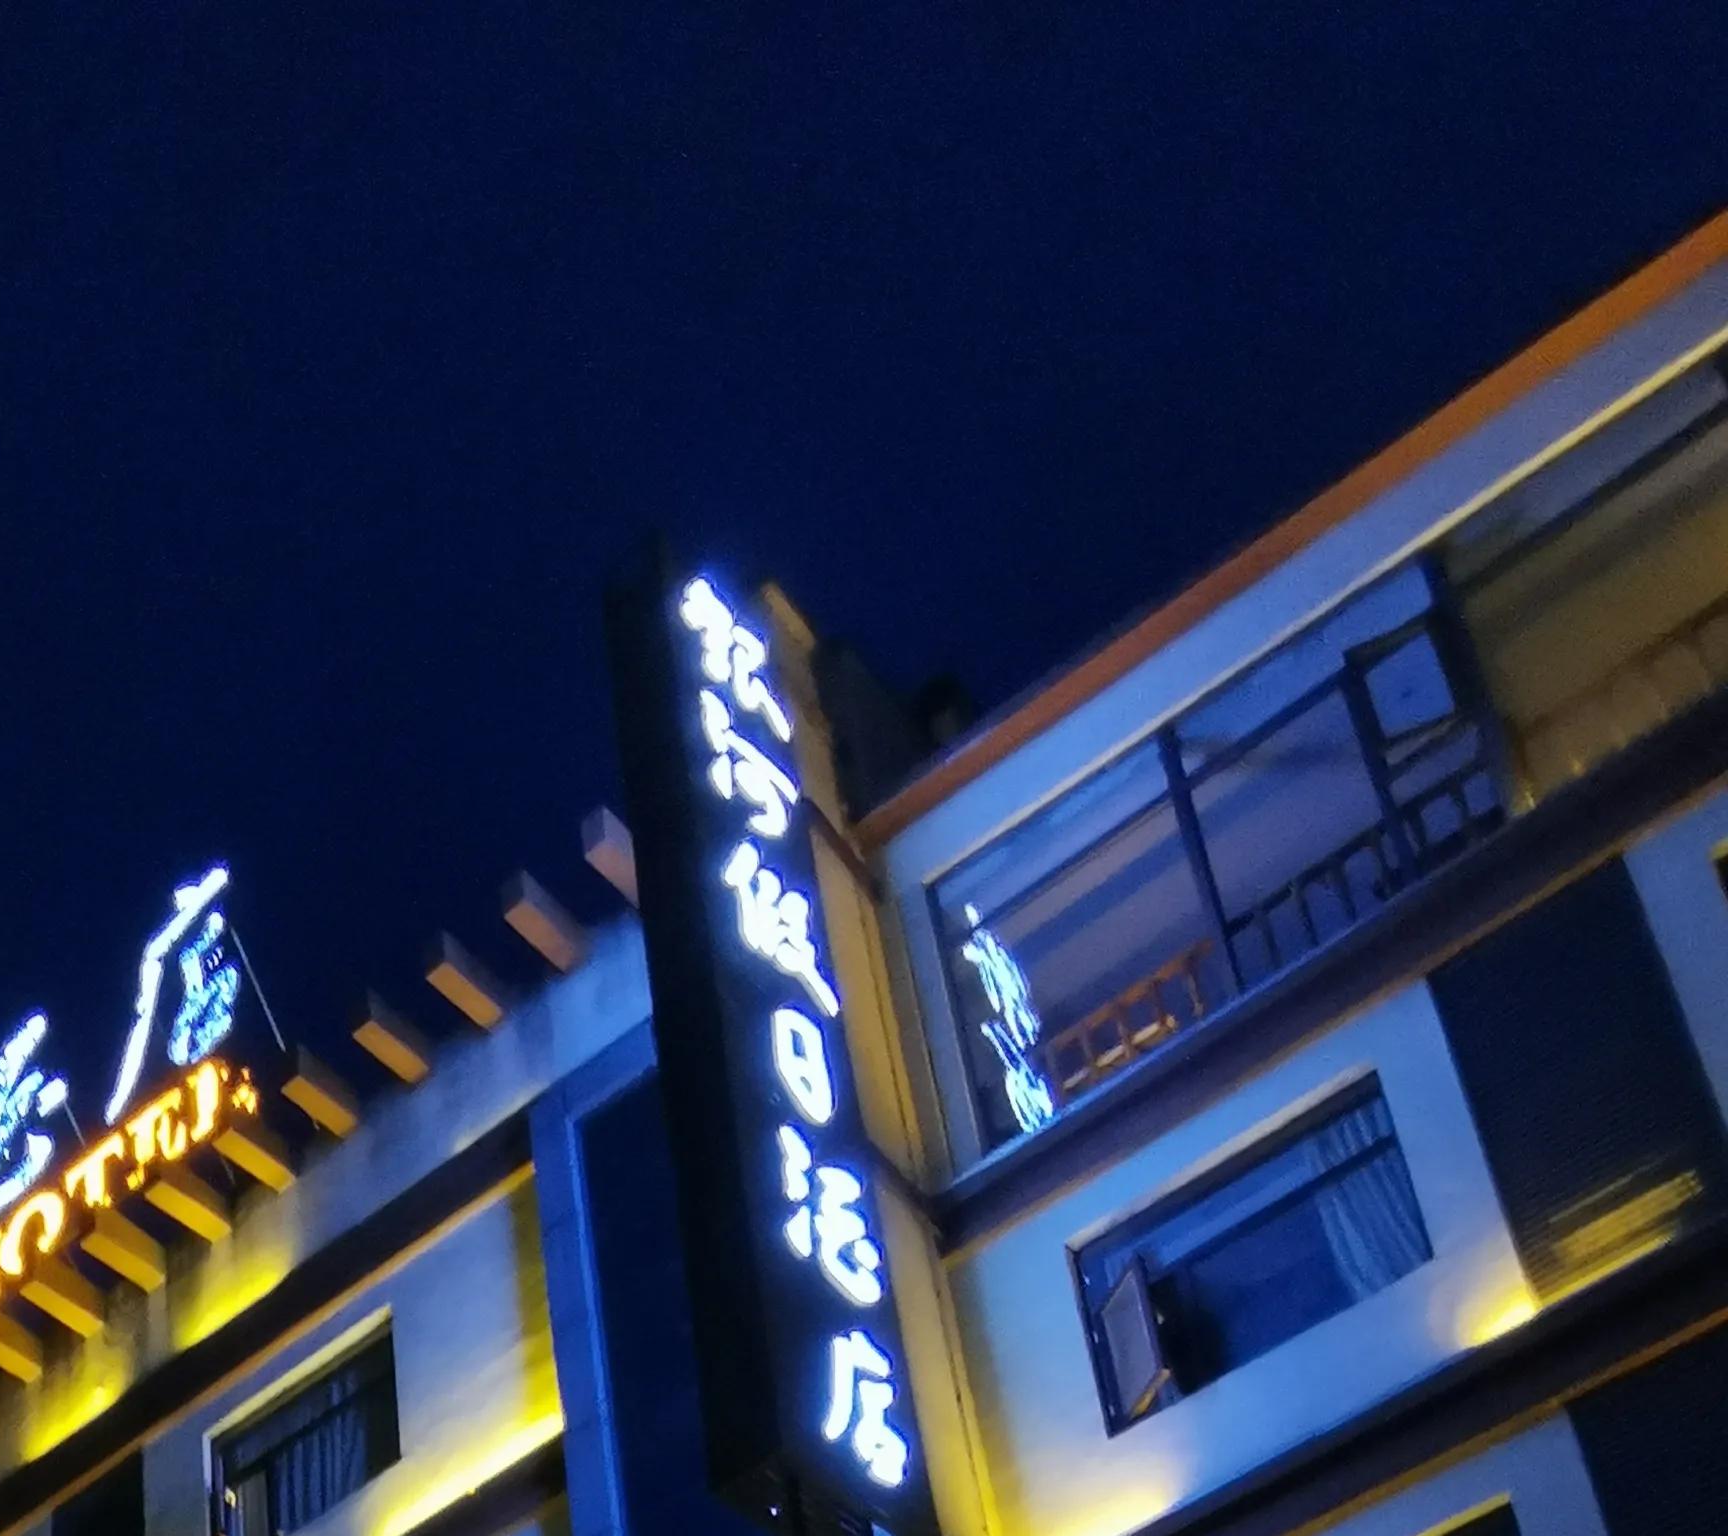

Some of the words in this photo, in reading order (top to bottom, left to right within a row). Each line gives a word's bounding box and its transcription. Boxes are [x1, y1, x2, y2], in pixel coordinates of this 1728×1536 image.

[682, 575, 908, 1487] 银河假日酒店
